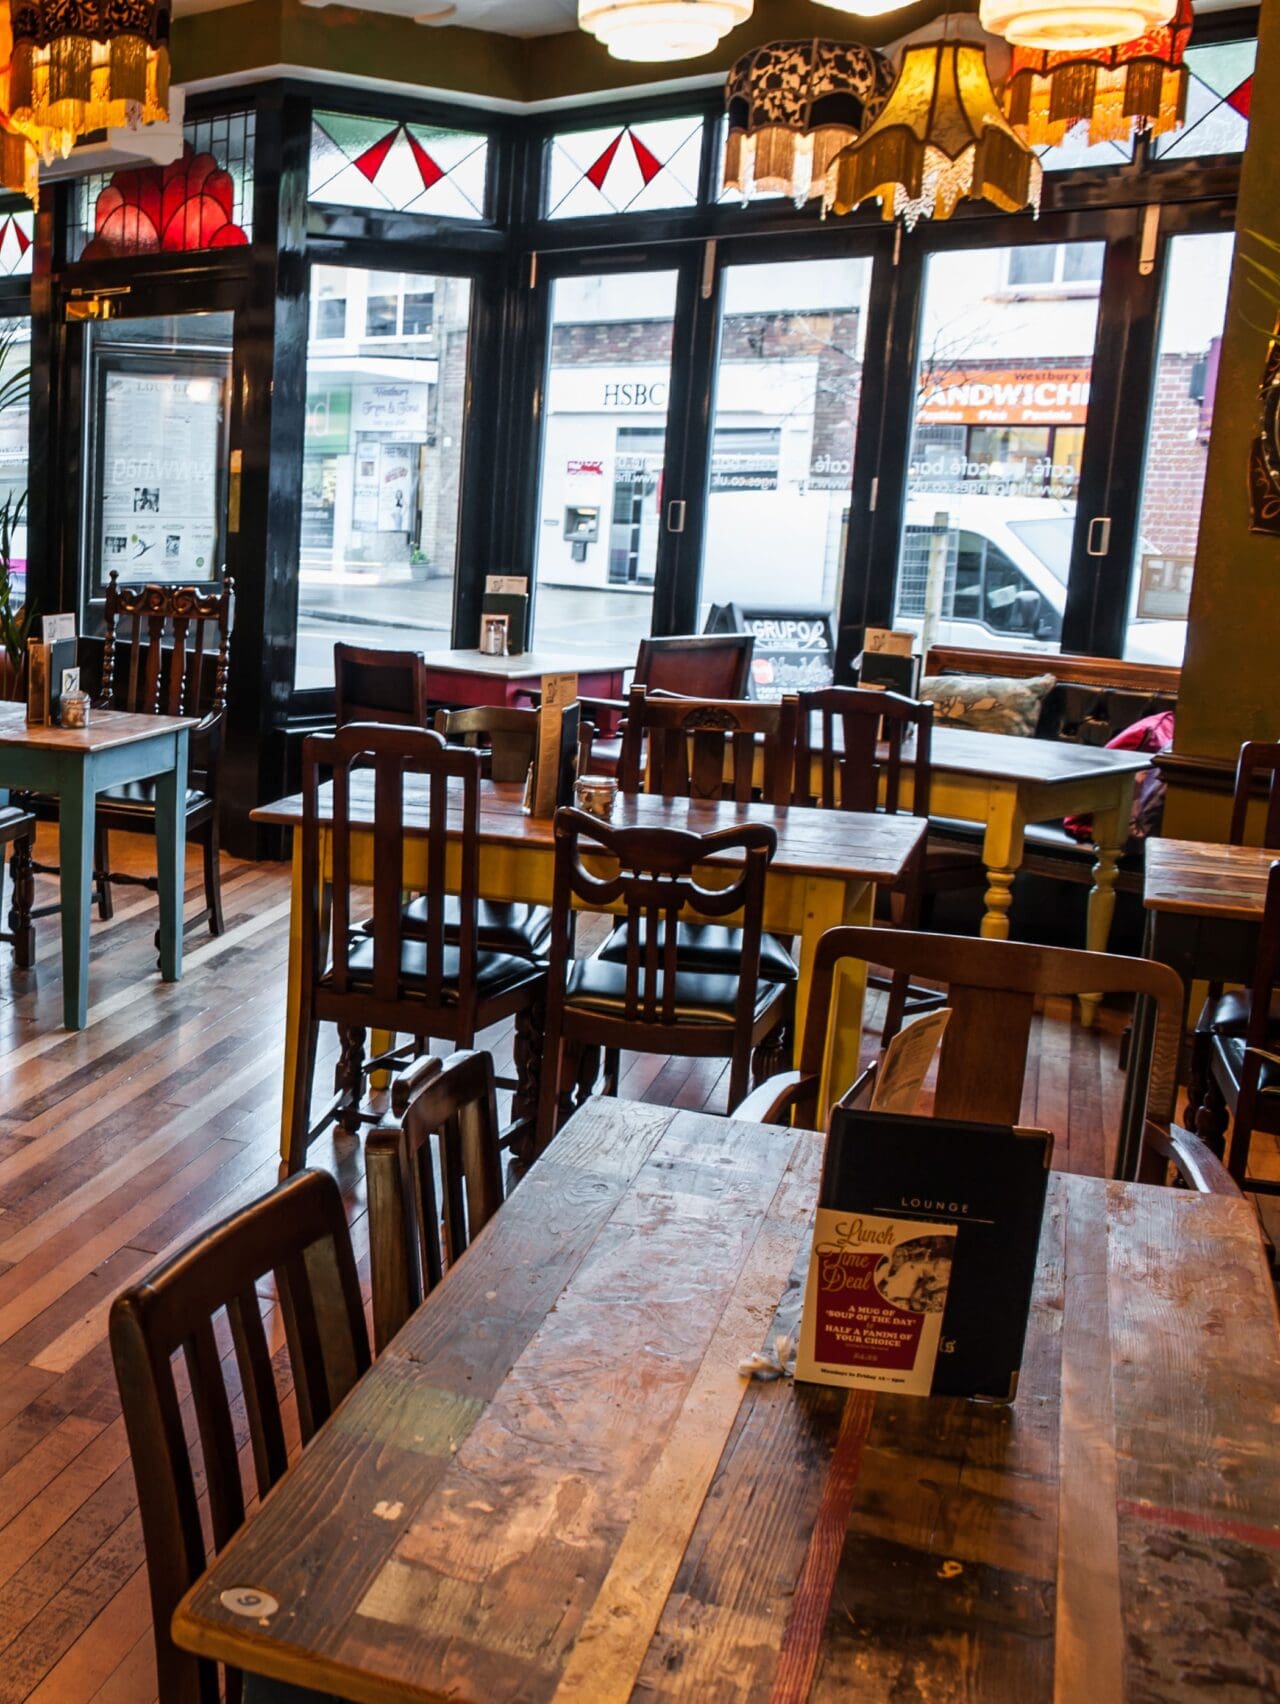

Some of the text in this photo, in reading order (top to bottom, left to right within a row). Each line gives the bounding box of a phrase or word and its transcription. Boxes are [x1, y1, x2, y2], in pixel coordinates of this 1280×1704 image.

[1014, 371, 1079, 382] Westbury
[603, 383, 665, 406] HSBC
[752, 620, 810, 639] GRUPO
[901, 1197, 969, 1214] LOUNGE
[835, 1219, 895, 1246] Lunch
[815, 1241, 870, 1269] Time
[821, 1260, 870, 1292] Deal
[848, 1305, 896, 1317] A MUG OF
[856, 1311, 870, 1322] OF
[871, 1315, 891, 1325] THE
[825, 1324, 852, 1334] HALF
[853, 1328, 861, 1336] A
[862, 1329, 897, 1340] PANINI
[835, 1333, 863, 1344] YOUR
[864, 1336, 901, 1348] CHOICE
